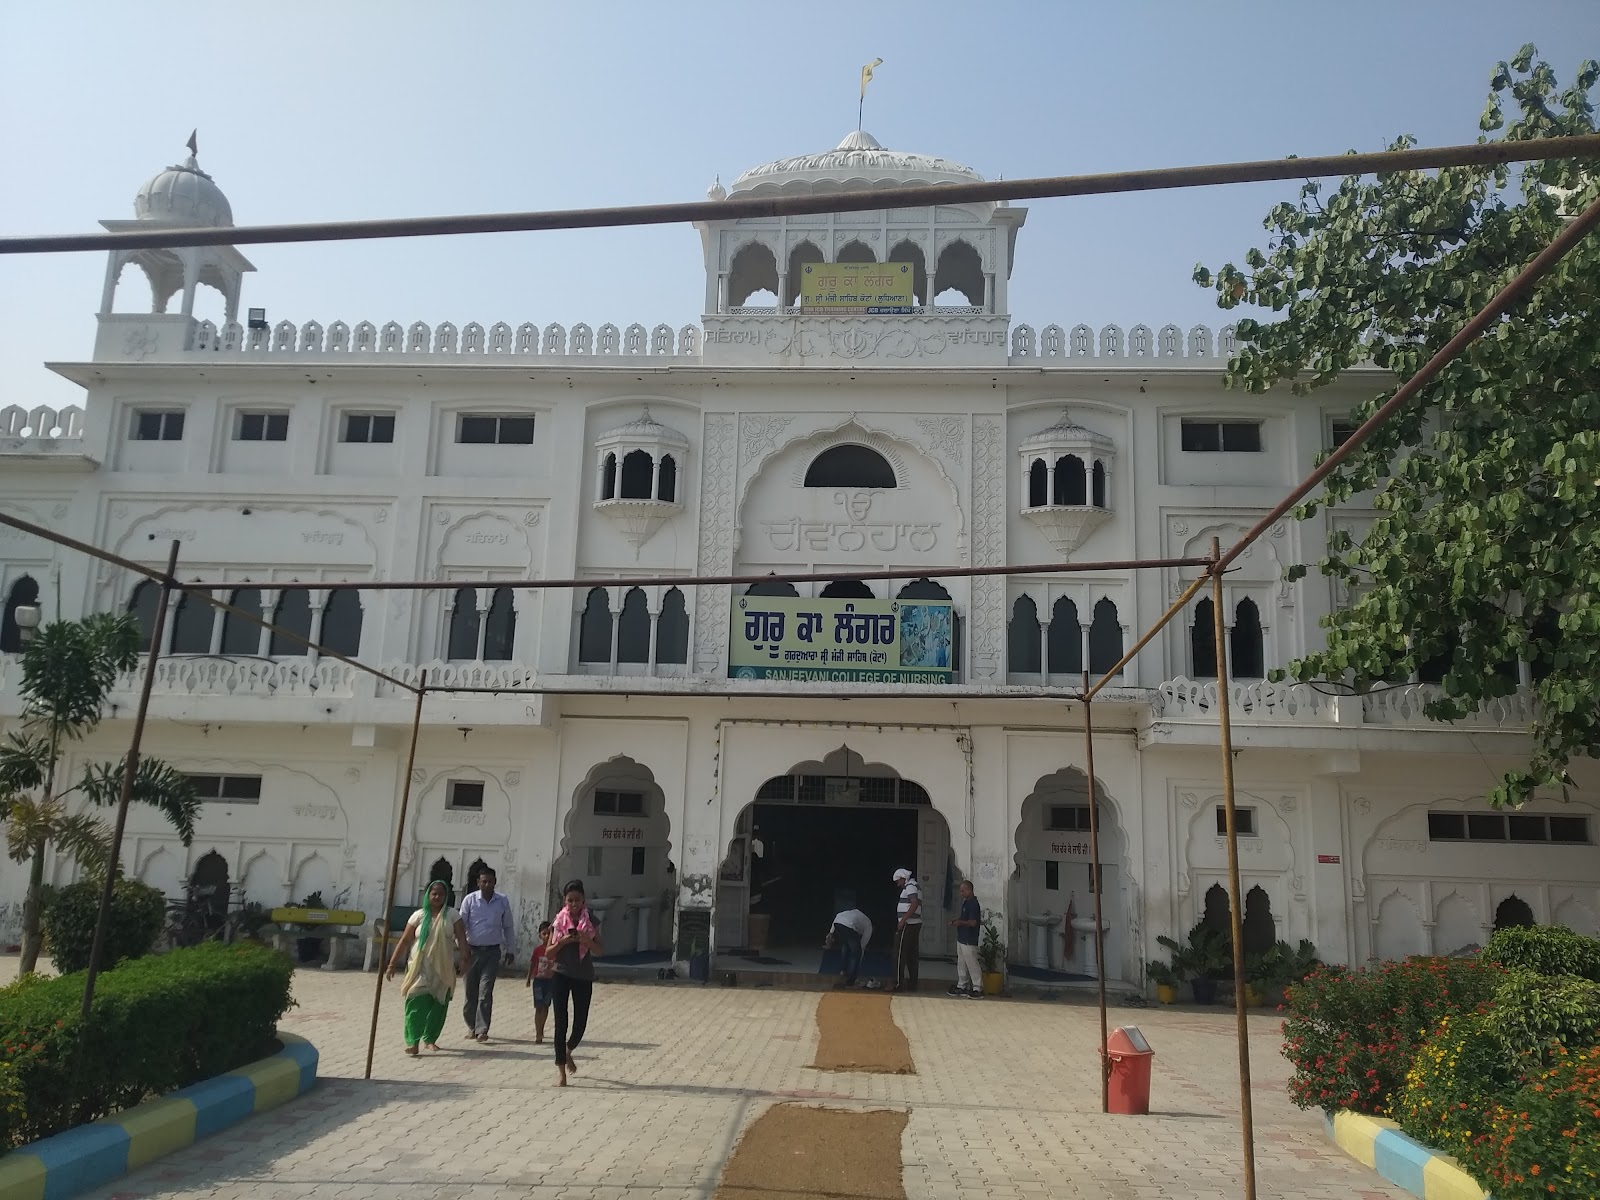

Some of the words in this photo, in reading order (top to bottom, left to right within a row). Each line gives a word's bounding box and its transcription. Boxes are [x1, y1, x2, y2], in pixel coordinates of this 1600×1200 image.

[818, 276, 838, 293] ਗੁਰੂ
[843, 275, 858, 287] ਕਾ
[864, 271, 895, 287] ਲੰਗਰ
[744, 611, 786, 659] ਗੁਰੂ
[796, 612, 823, 643] ਕਾ
[833, 603, 897, 645] ਲੰਗਰ
[784, 650, 818, 663] ਗੁਰਦੁਆਰਾ
[820, 648, 829, 665] ਸ੍ਰੀ
[831, 648, 845, 663] ਮੰਜੀ
[847, 649, 868, 663] ਸਾਹਿਬ
[765, 669, 829, 681] SANJEEVANI
[831, 671, 881, 683] COLLEGE
[883, 673, 898, 683] OF
[899, 674, 946, 685] NURSING
